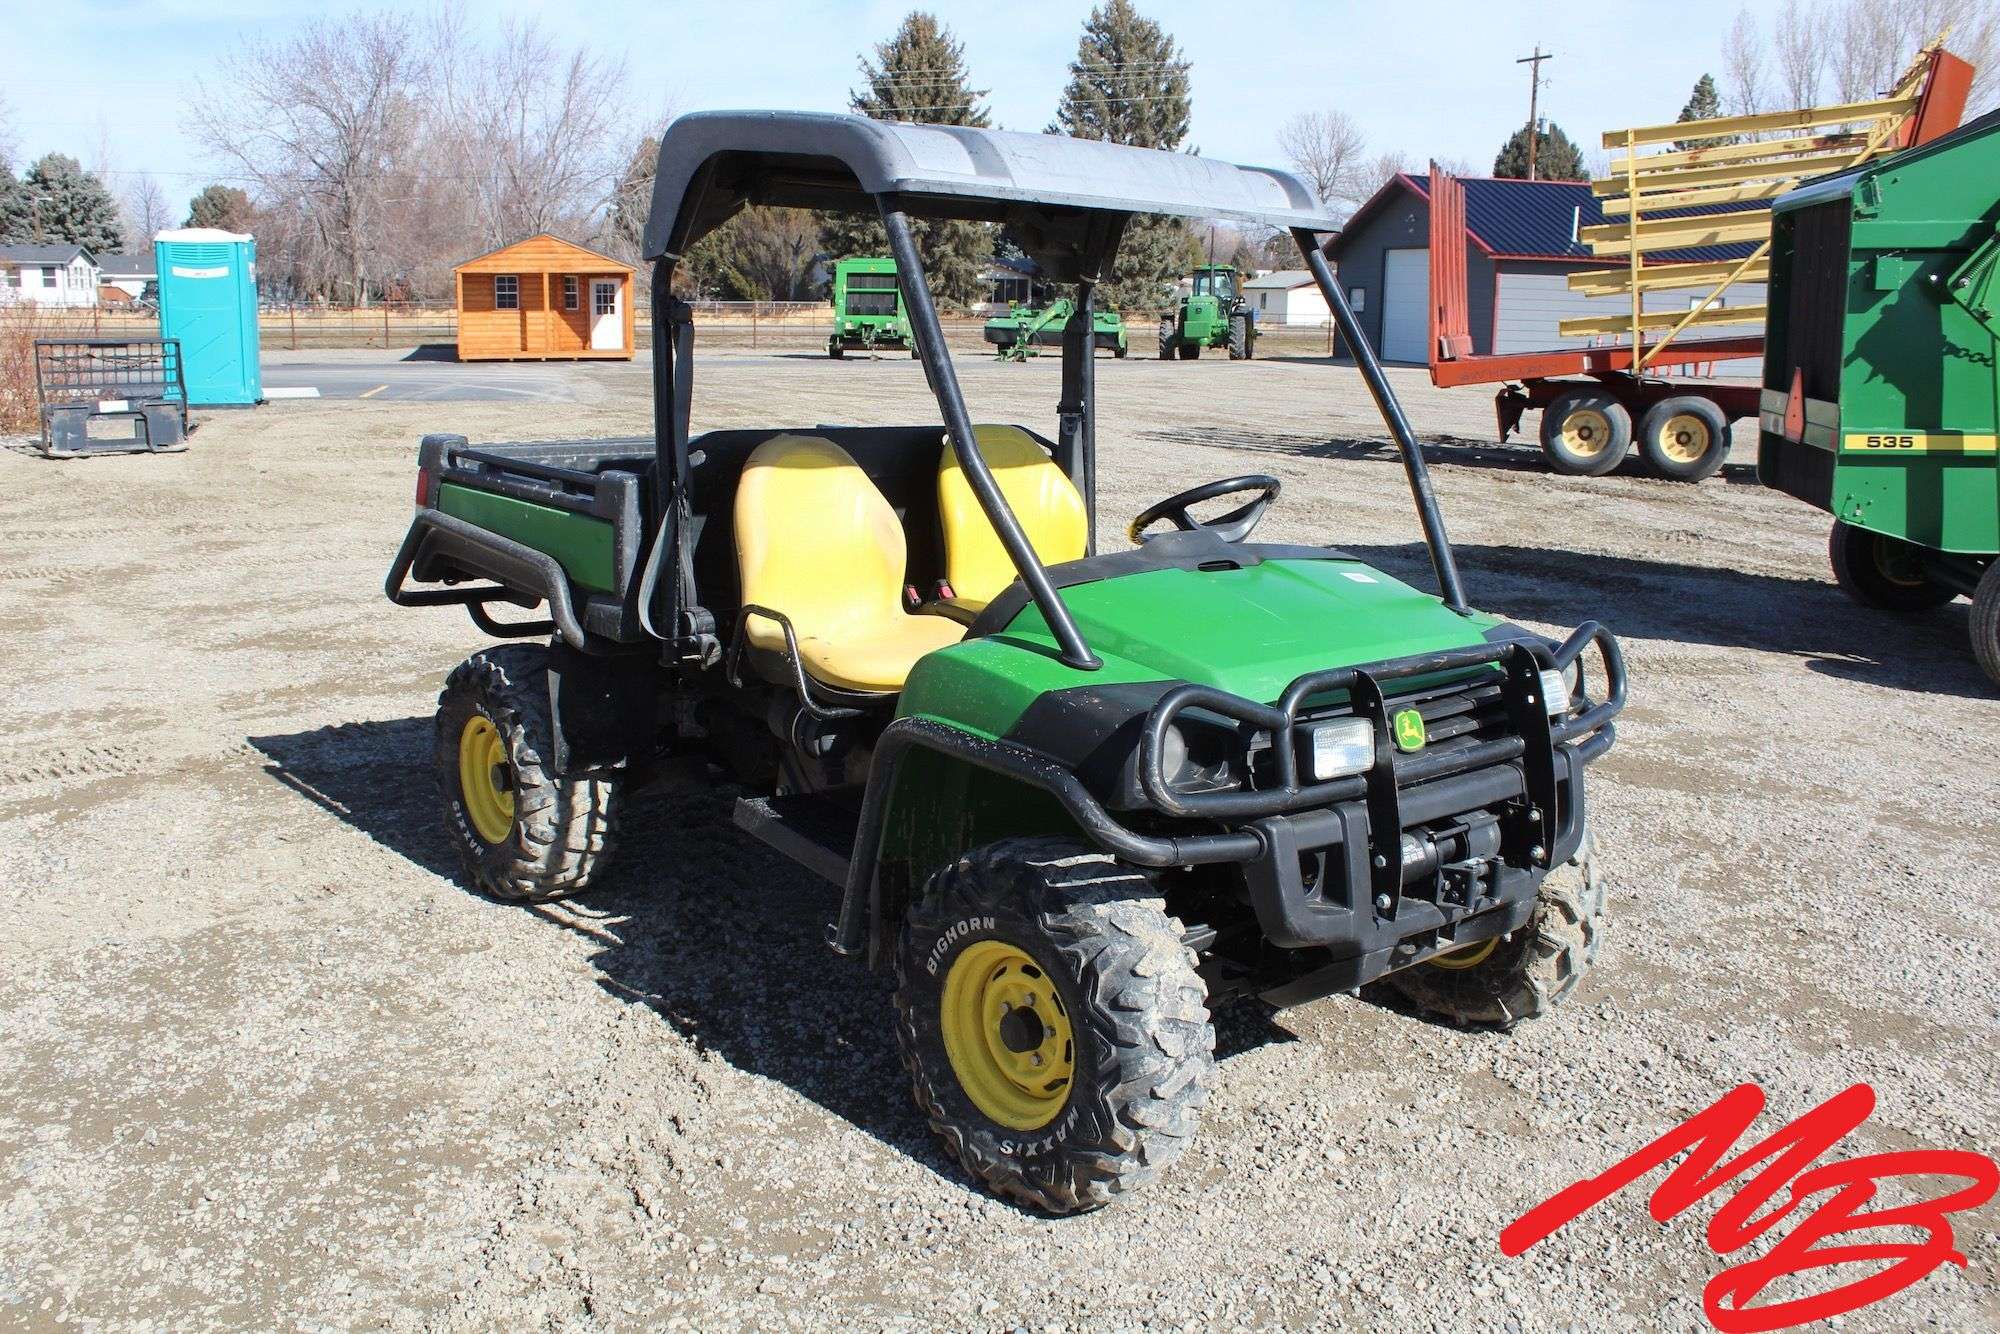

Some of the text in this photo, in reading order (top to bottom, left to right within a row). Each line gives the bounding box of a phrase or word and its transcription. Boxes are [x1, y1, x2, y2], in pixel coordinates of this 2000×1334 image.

[1866, 436, 1914, 448] 535
[926, 916, 996, 977] BIGHORN
[999, 1105, 1080, 1157] MAXXIS
